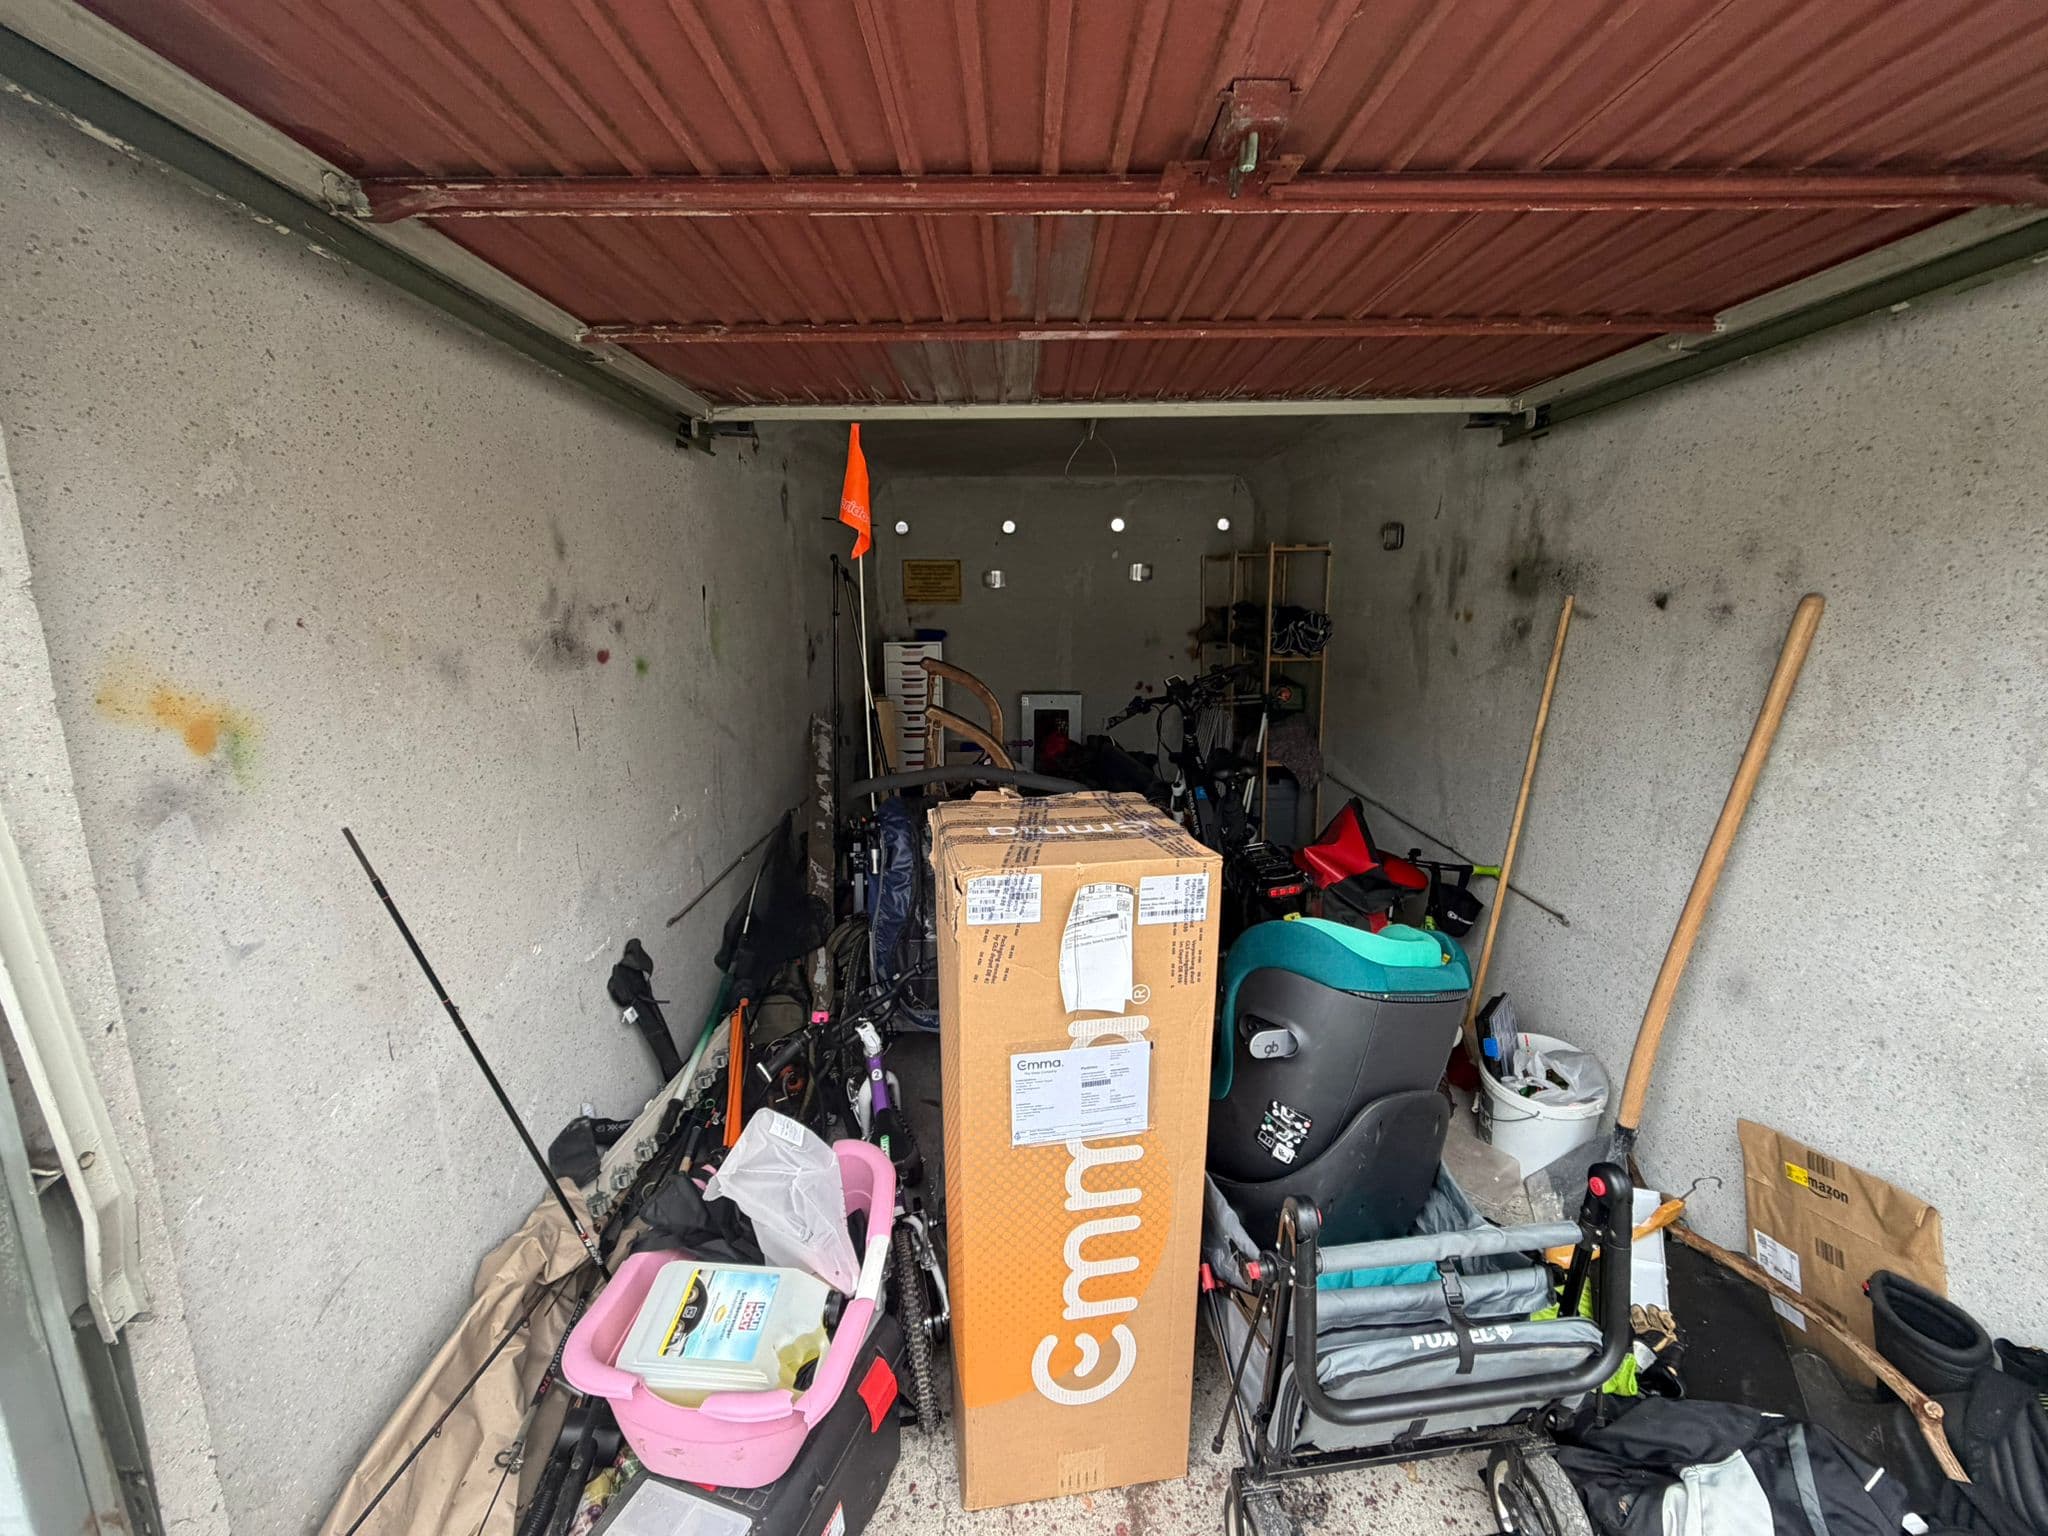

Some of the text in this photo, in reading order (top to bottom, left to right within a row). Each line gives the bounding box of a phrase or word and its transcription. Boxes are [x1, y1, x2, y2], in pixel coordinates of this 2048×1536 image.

[1264, 1040, 1279, 1058] gb
[873, 1070, 880, 1079] 2
[738, 1302, 757, 1330] MOLY
[747, 1302, 766, 1330] LIQUI
[1410, 1326, 1497, 1351] FUXEC
